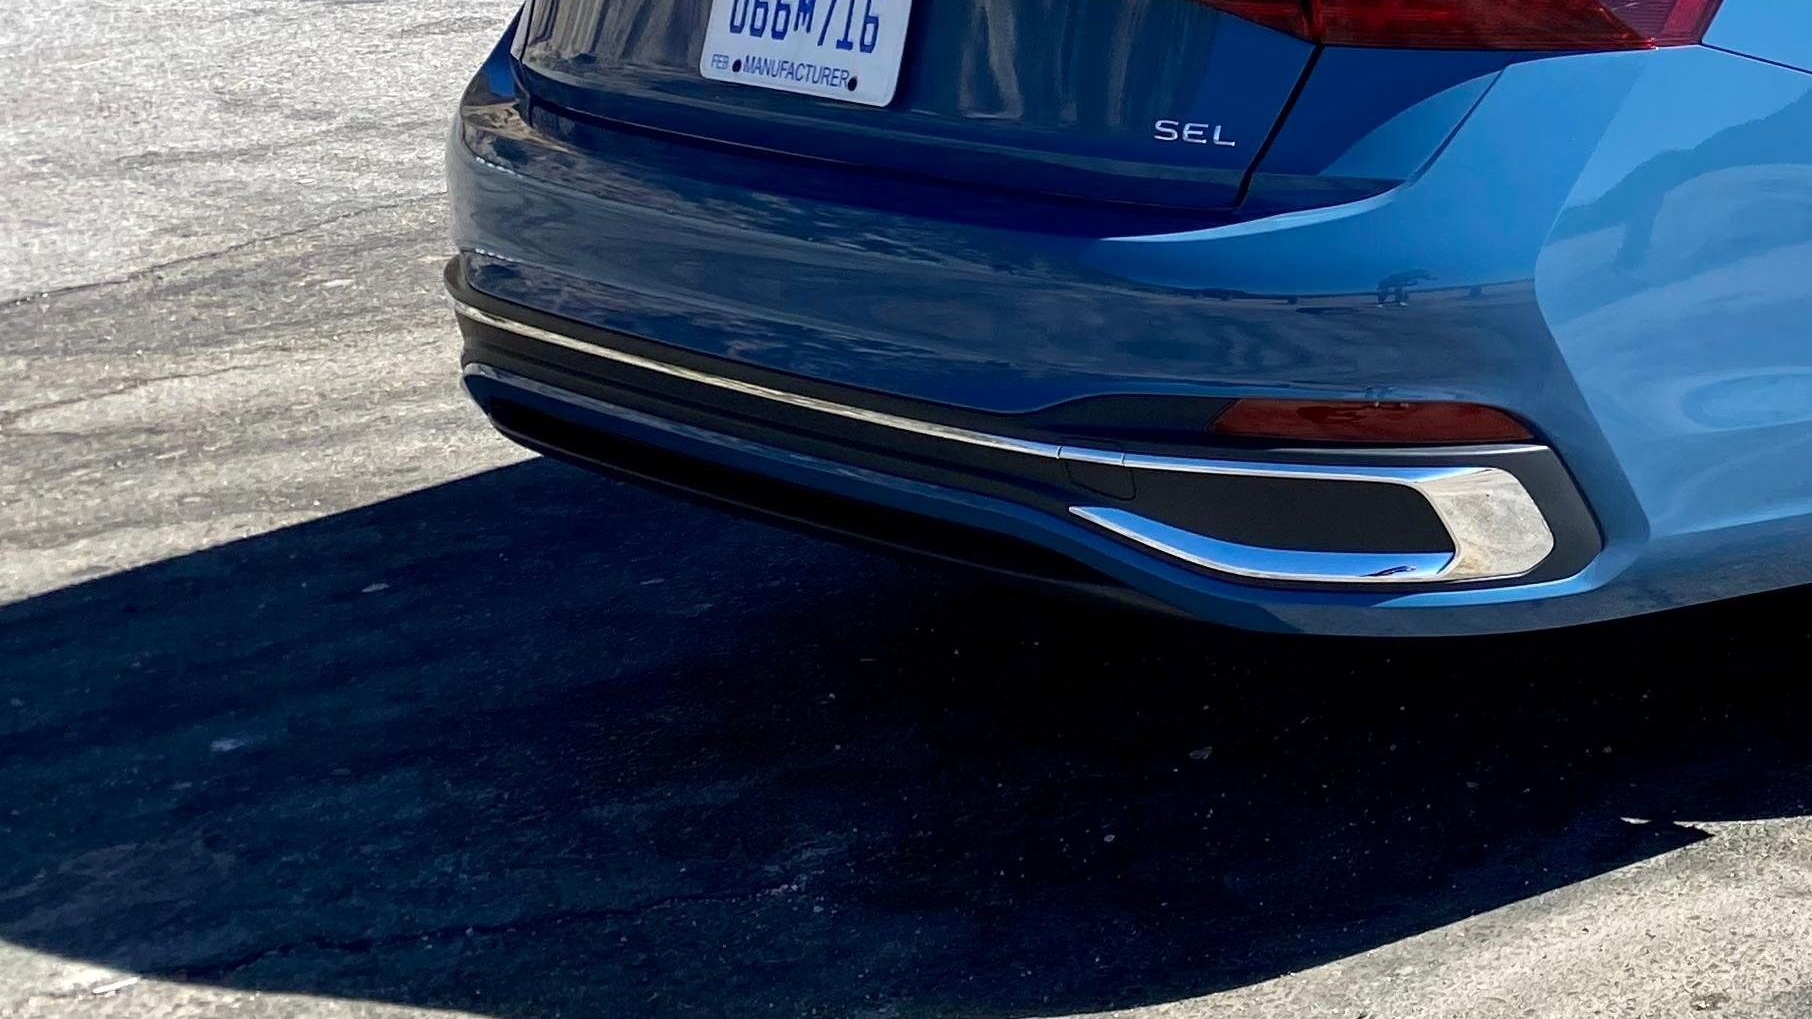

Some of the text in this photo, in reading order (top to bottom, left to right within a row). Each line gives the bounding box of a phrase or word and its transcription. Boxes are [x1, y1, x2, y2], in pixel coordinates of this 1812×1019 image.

[711, 53, 729, 70] FEB
[743, 54, 850, 89] MANUFACTURER
[1154, 119, 1236, 147] SEL
